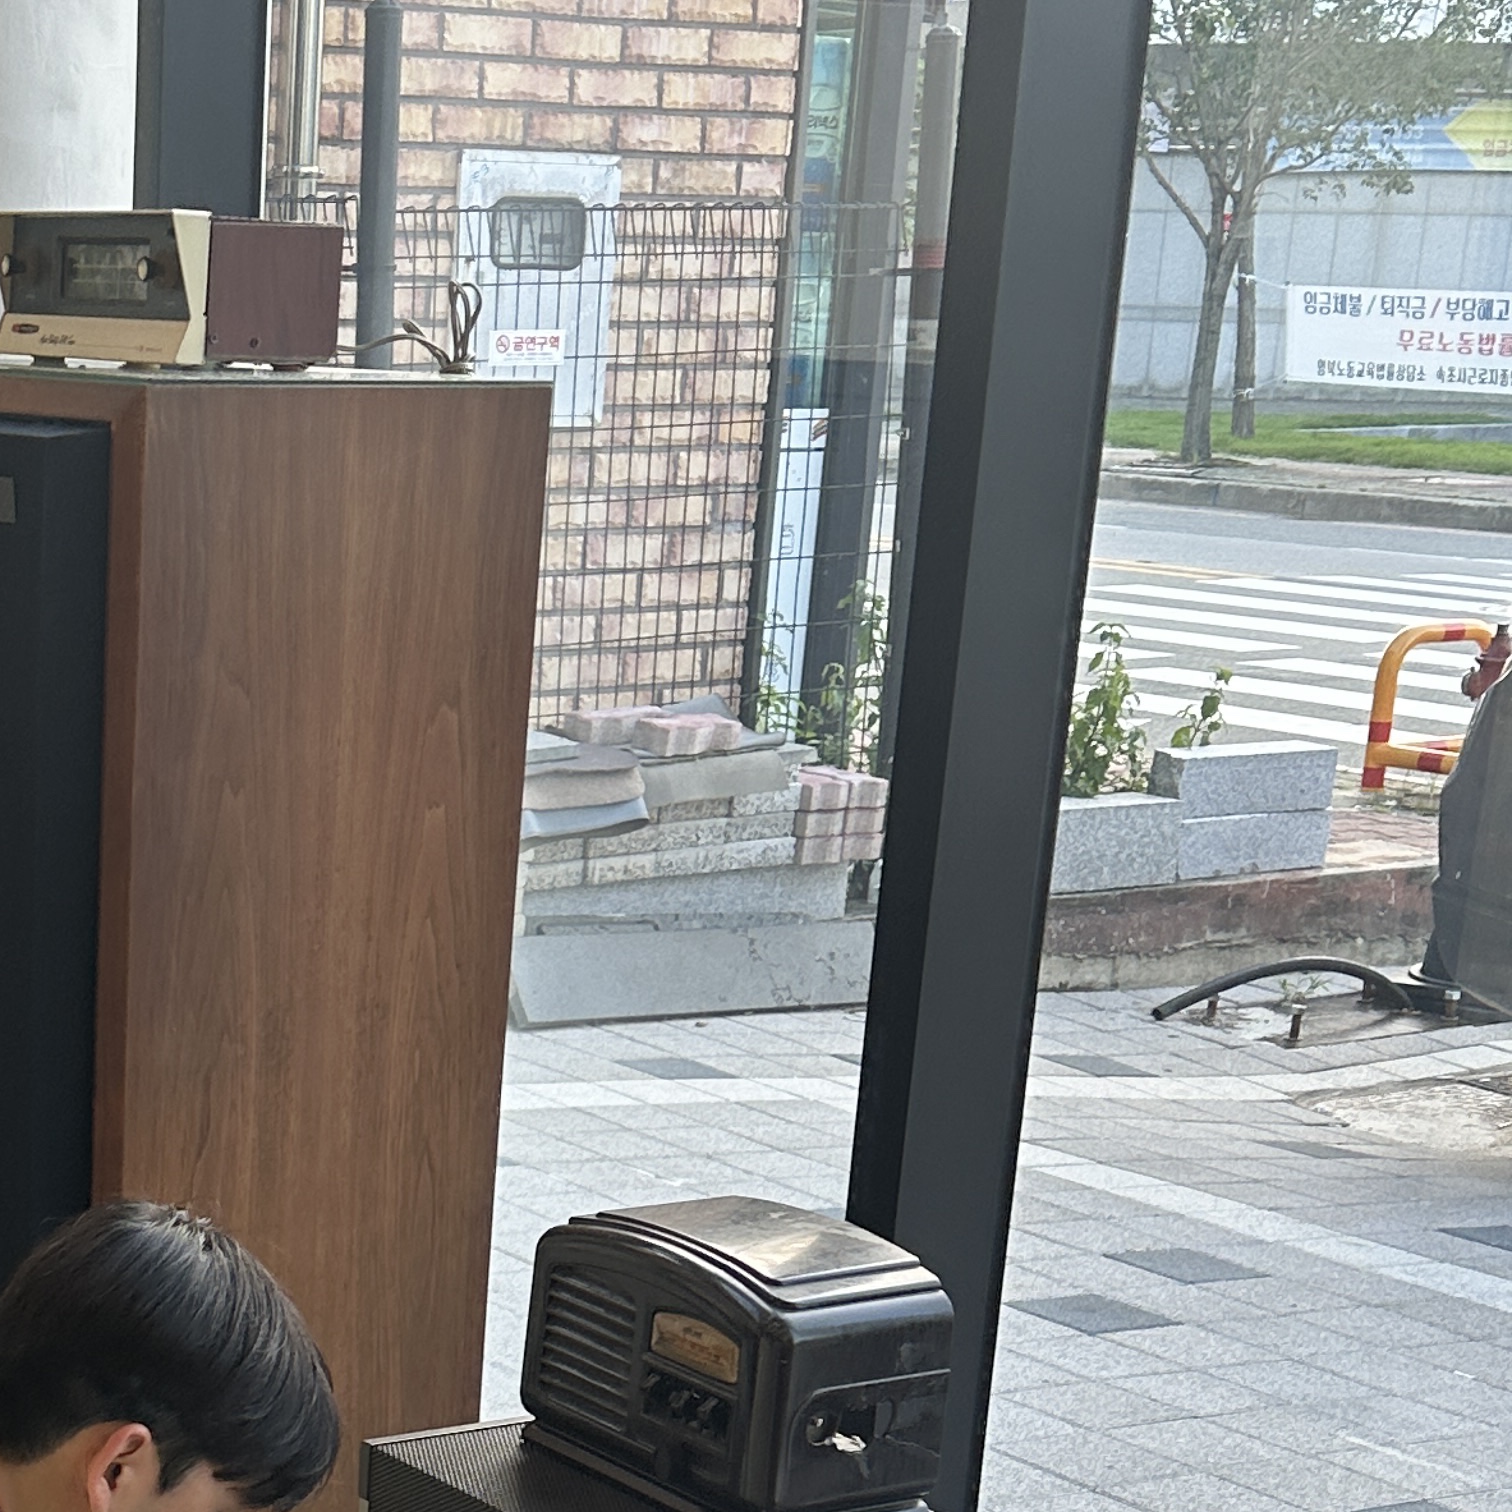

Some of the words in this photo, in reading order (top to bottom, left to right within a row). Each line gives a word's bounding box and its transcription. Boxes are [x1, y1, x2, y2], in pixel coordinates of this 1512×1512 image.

[1303, 291, 1363, 317] 임금체불
[1380, 295, 1426, 320] 퇴직금
[1445, 297, 1511, 321] 부당해고
[512, 335, 560, 352] 금연구역
